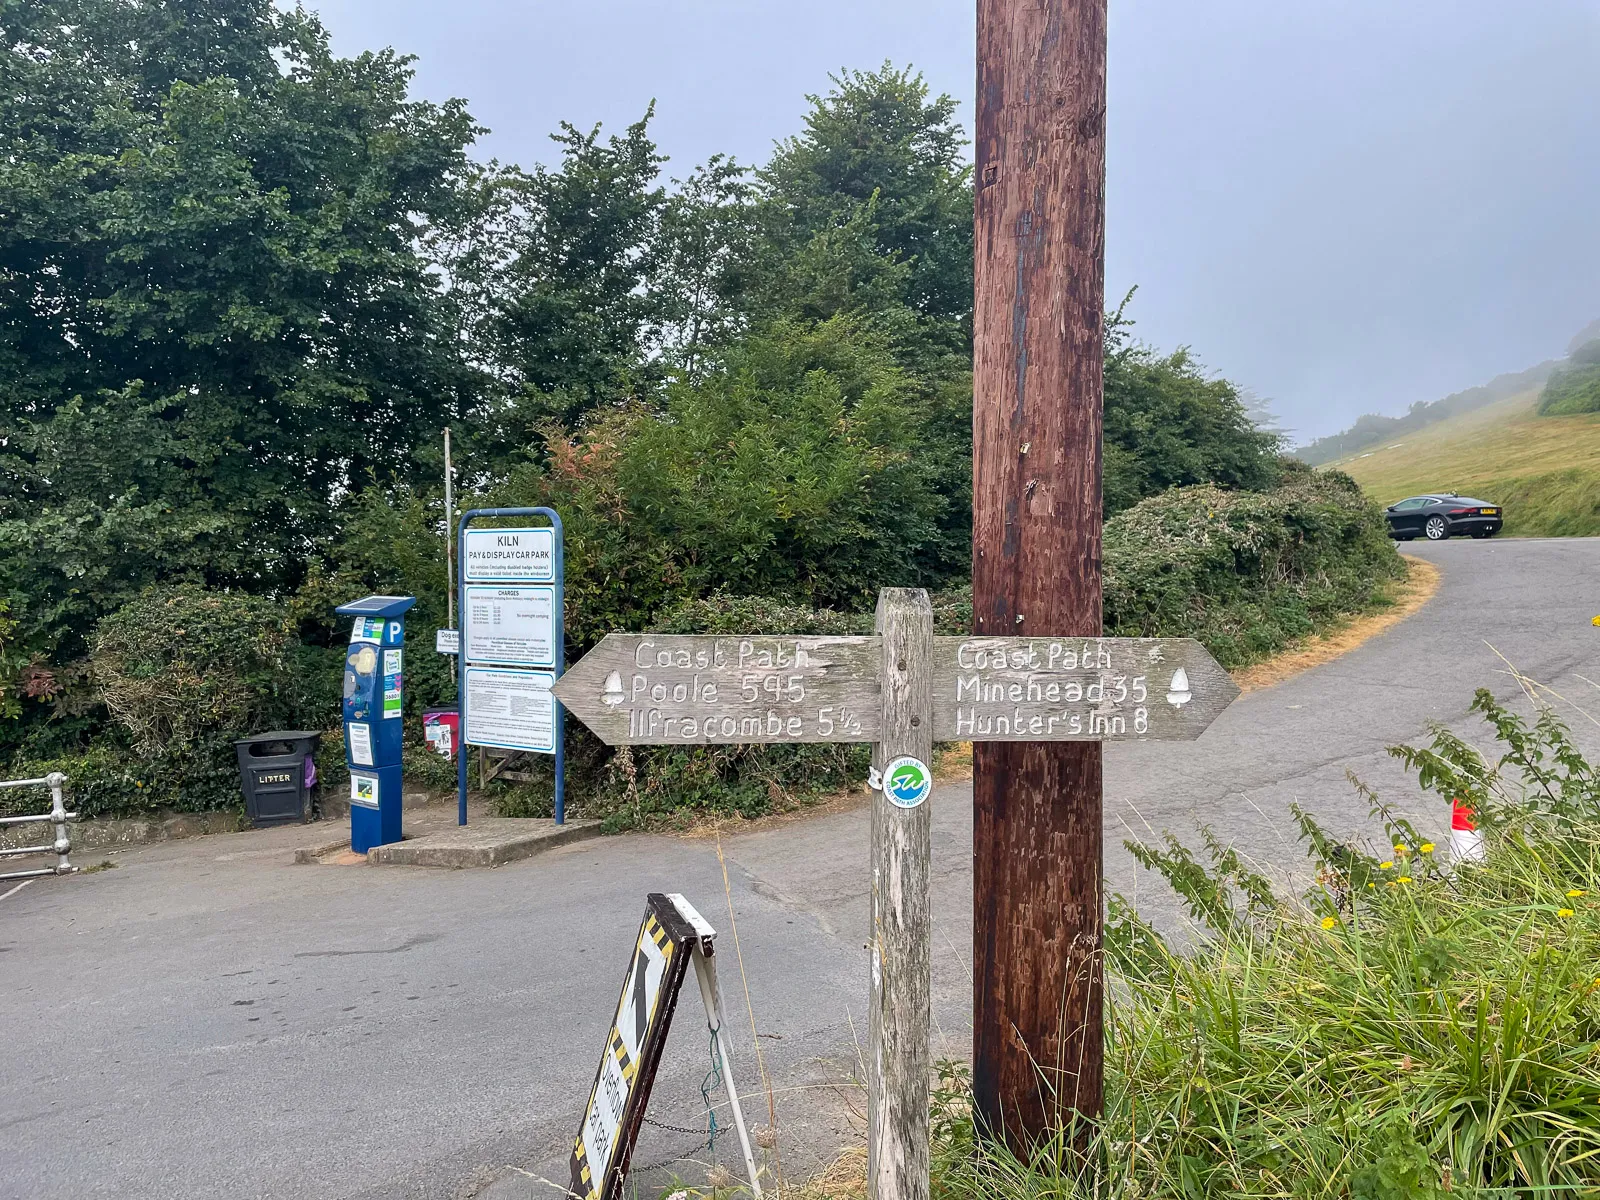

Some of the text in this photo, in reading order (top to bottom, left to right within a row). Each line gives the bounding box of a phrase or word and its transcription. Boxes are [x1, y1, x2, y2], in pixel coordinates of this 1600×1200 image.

[497, 535, 519, 547] KILN
[531, 550, 550, 559] PARK
[390, 621, 401, 643] P
[441, 631, 451, 640] Dog
[635, 640, 811, 669] Coast Path
[956, 642, 1112, 670] Coast Path
[630, 674, 807, 703] Poole 595
[956, 675, 1148, 703] Minehead 35
[628, 708, 804, 738] Ilfracombe
[956, 706, 1149, 735] Hunter's Inn 8
[894, 760, 923, 769] GIFTED BY
[259, 774, 290, 783] LITTER
[886, 780, 929, 806] COAST PATH ASSOCIATION
